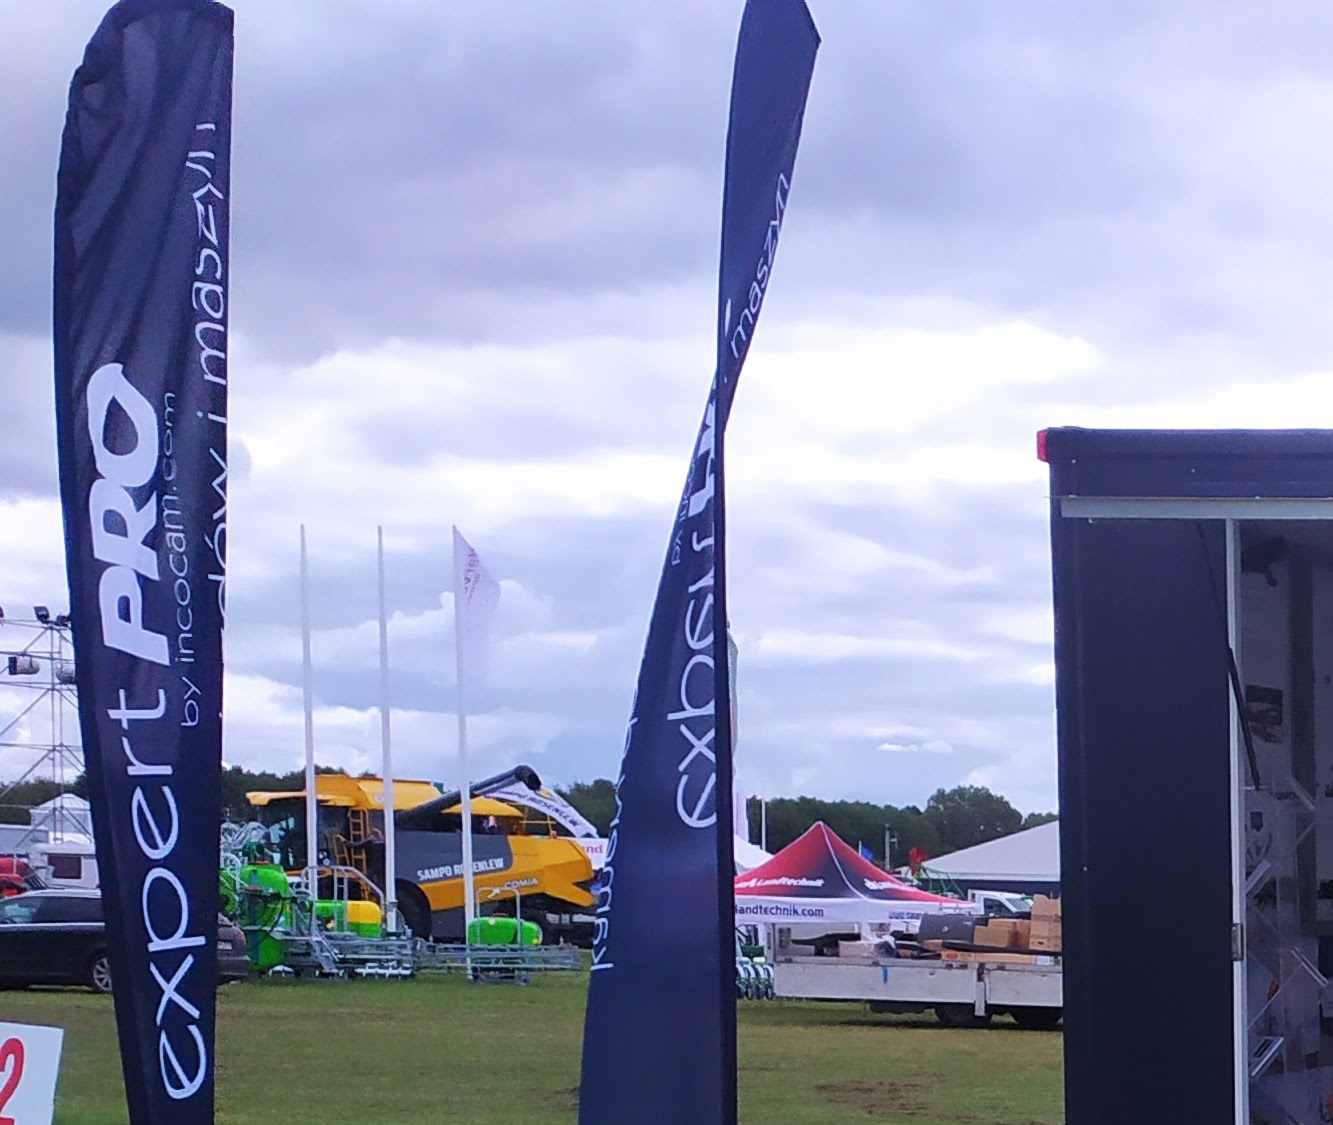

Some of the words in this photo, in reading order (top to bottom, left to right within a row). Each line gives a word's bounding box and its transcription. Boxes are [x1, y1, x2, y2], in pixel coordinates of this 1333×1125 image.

[730, 173, 790, 359] maszyn
[86, 362, 171, 668] PRO
[161, 391, 194, 665] incocam.com
[180, 677, 200, 728] by
[109, 686, 207, 1100] expert
[417, 866, 453, 881] SAMPO
[453, 858, 504, 877] RENLEW
[504, 878, 539, 890] COMIA
